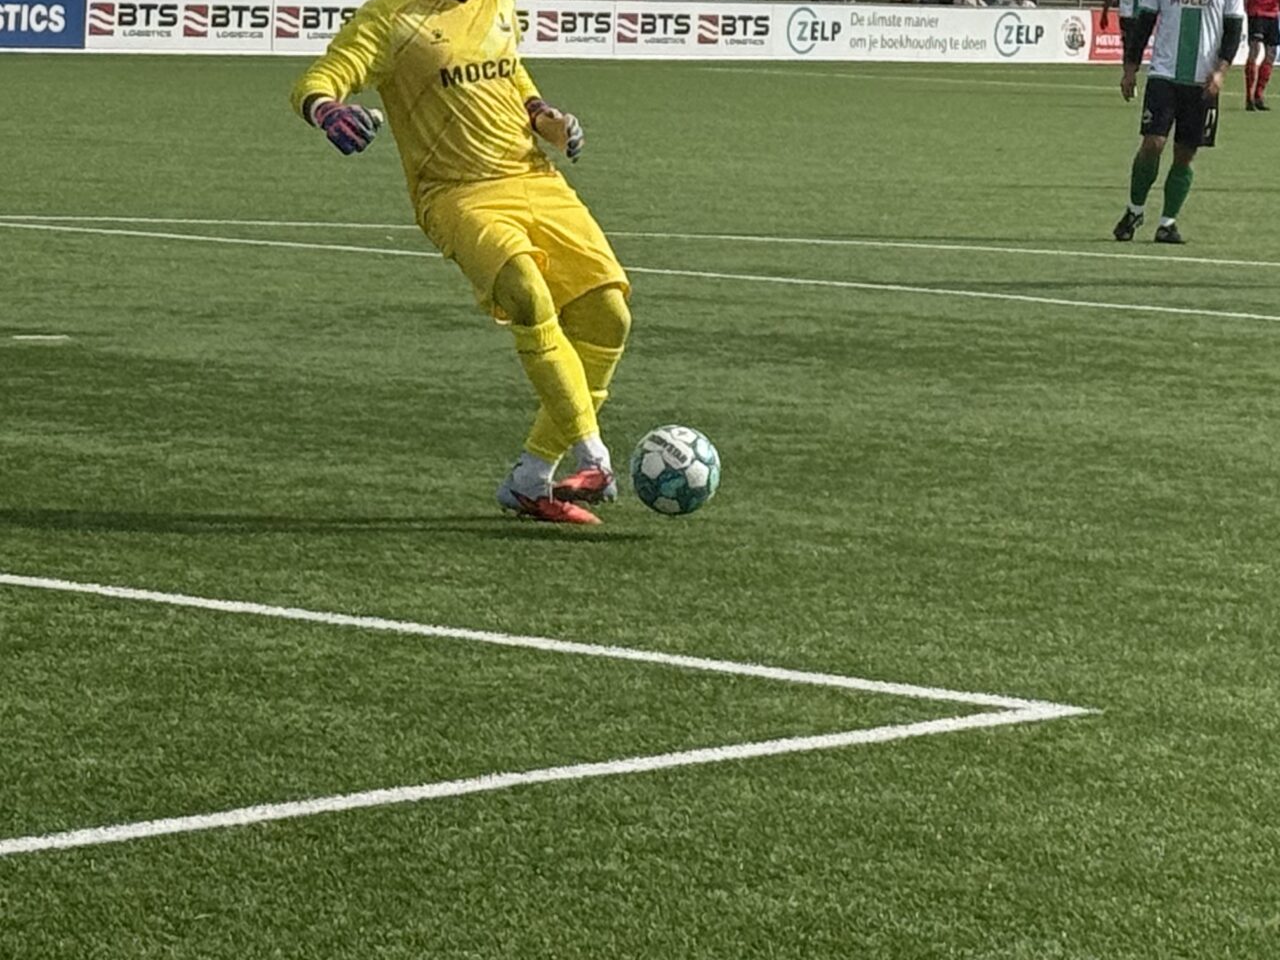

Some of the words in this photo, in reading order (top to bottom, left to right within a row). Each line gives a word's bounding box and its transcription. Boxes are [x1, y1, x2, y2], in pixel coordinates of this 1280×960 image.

[0, 3, 66, 33] TICS
[118, 3, 178, 27] BTS
[211, 5, 270, 29] BTS
[561, 12, 611, 34] BTS
[640, 13, 690, 36] BTS
[721, 15, 769, 36] BTS
[851, 13, 865, 26] De
[904, 14, 939, 28] manier
[797, 21, 841, 42] ZELP
[1003, 25, 1044, 45] ZELP
[849, 37, 866, 48] om
[868, 36, 878, 52] je
[880, 33, 947, 53] boekhouding
[949, 36, 960, 50] te
[962, 36, 986, 50] doen
